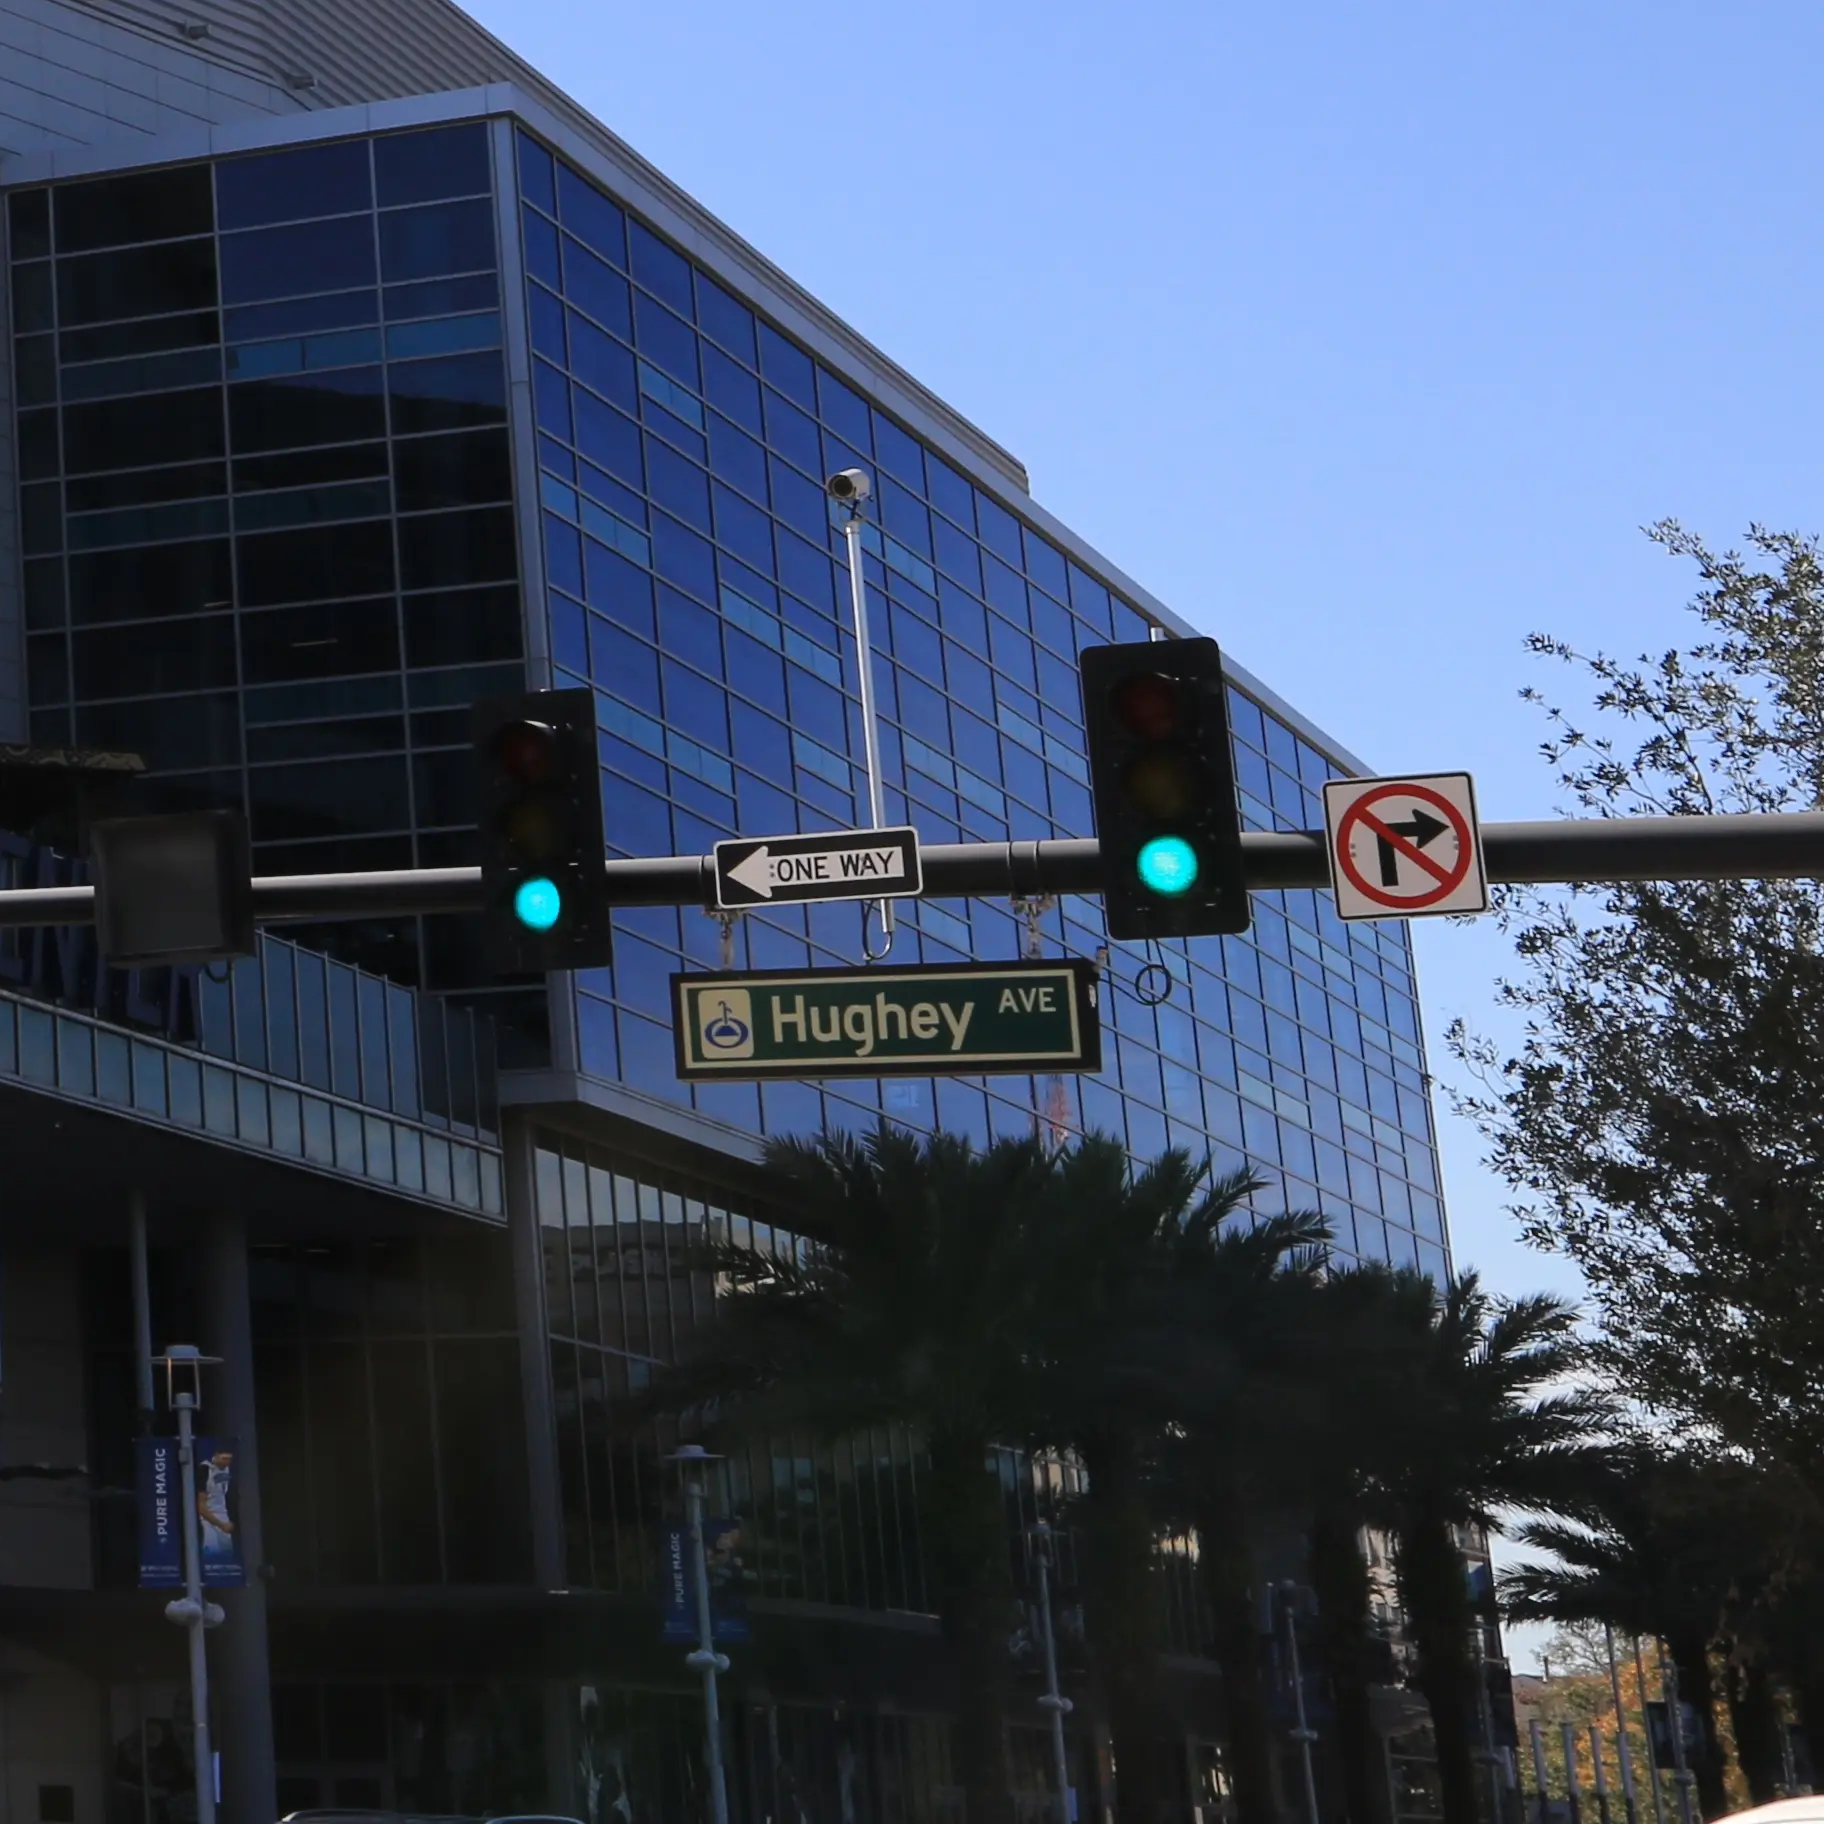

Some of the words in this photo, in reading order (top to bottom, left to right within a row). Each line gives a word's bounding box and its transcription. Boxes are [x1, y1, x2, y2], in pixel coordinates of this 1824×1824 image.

[776, 856, 831, 883] ONE
[839, 850, 895, 878] WAY
[770, 991, 975, 1057] Hughey
[998, 987, 1058, 1014] AVE
[155, 1448, 166, 1494] MAGIC
[157, 1498, 168, 1535] PURE
